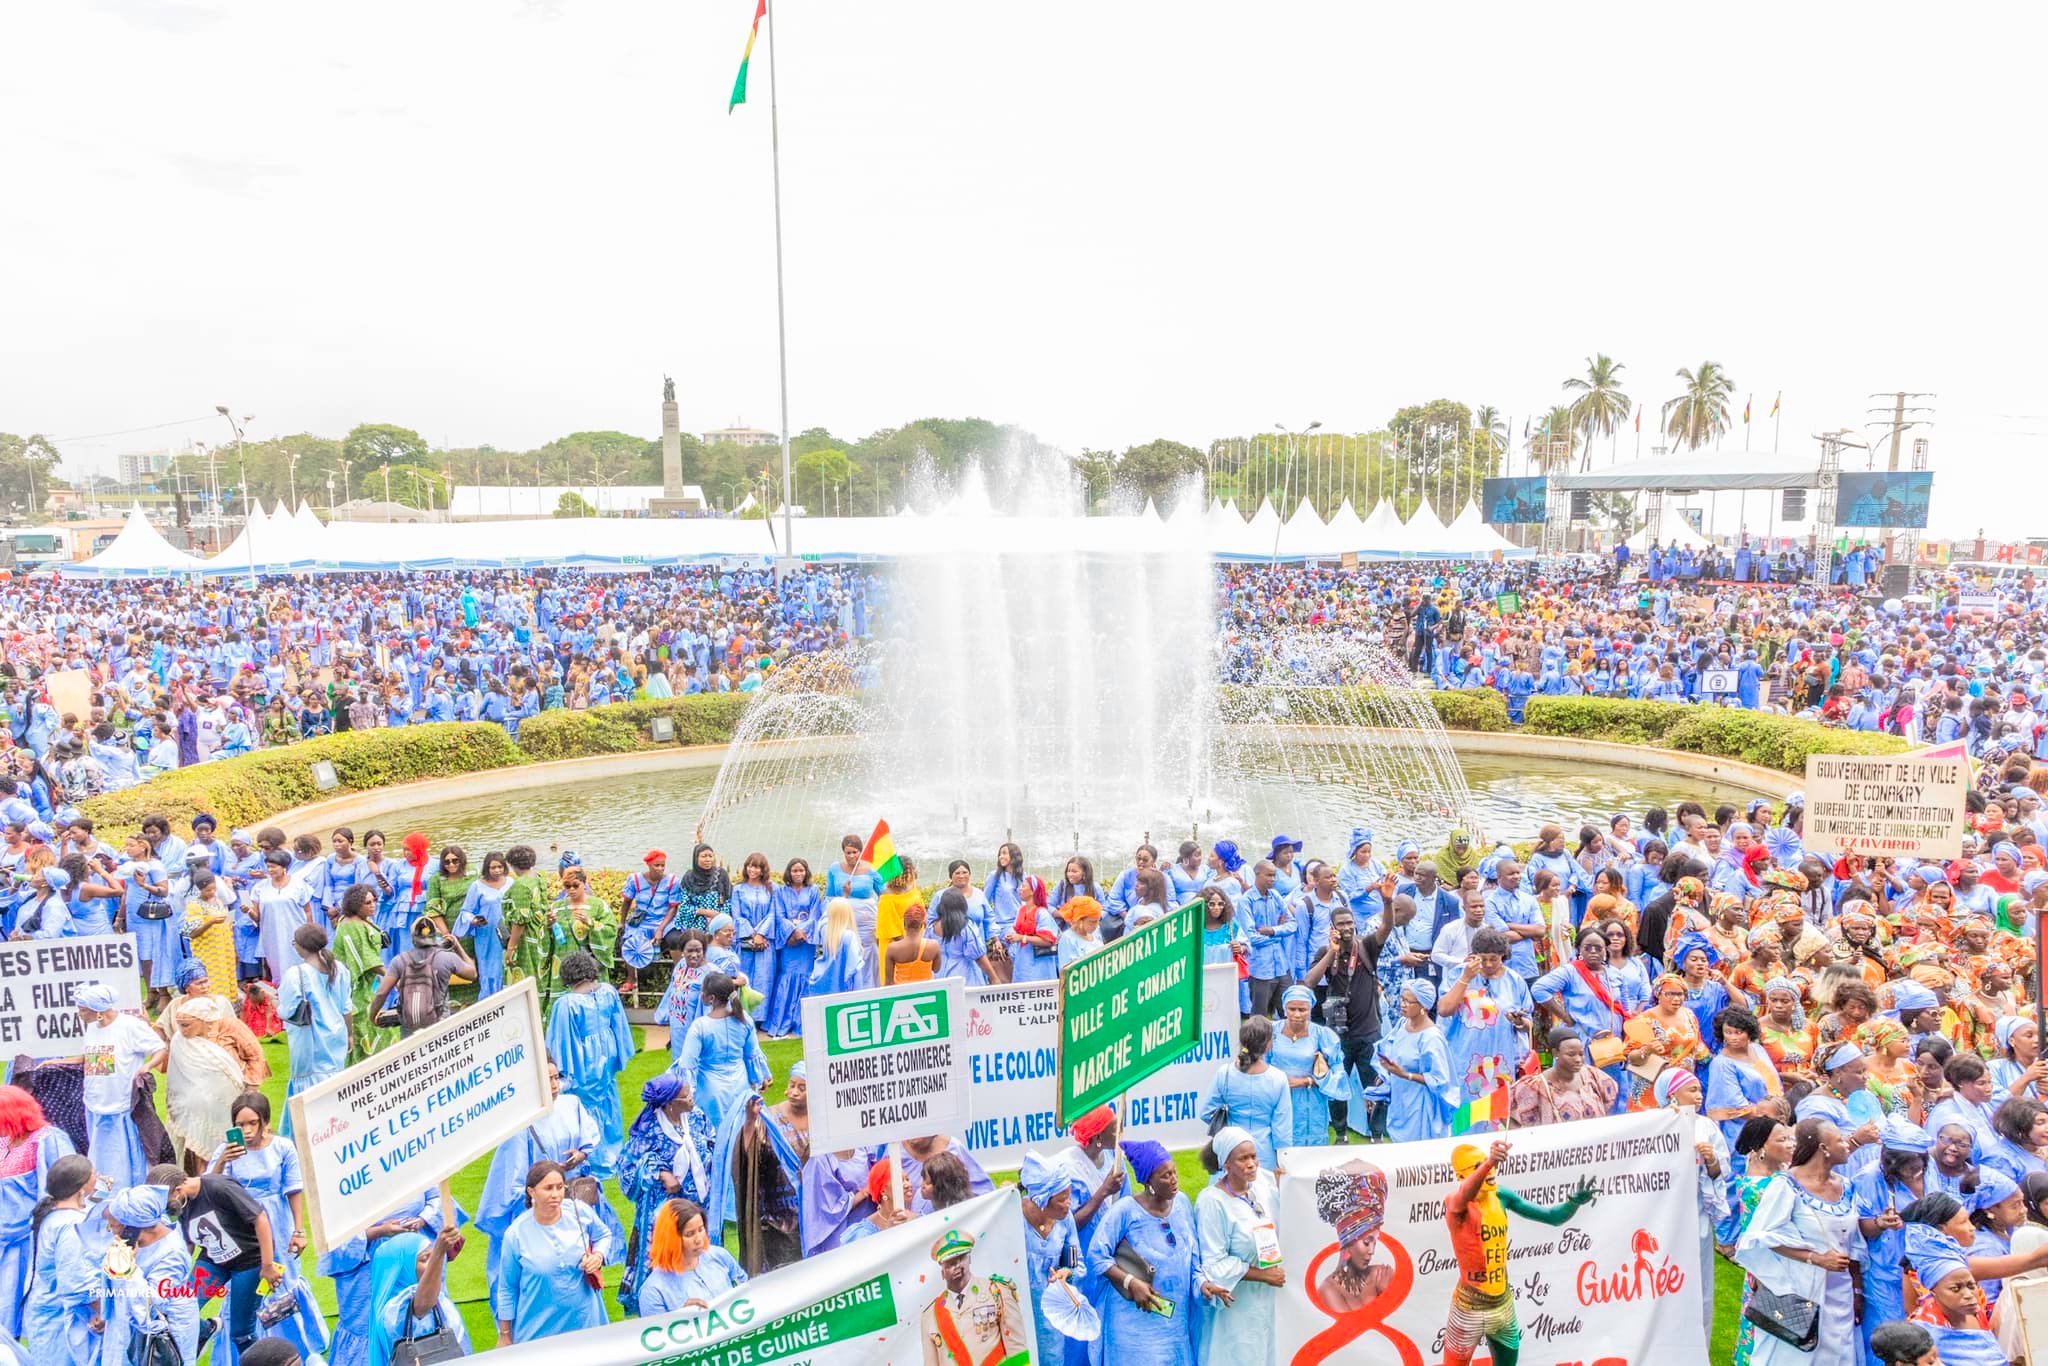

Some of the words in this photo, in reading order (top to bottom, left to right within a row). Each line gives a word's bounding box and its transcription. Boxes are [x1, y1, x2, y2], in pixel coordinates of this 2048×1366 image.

[1817, 761, 1892, 782] GOUVERNORAT
[1896, 764, 1908, 783] DE
[1913, 765, 1925, 783] LA
[1929, 765, 1957, 784] VILLE
[1845, 784, 1859, 800] DE
[1864, 785, 1925, 803] CONAKRY
[1814, 802, 1850, 818] BUREAU
[1852, 804, 1865, 818] DE
[1868, 804, 1954, 822] L'ADMINISTRATION
[1814, 819, 1826, 832] DU
[1829, 820, 1867, 835] MARCHE
[1869, 823, 1881, 836] DE
[1884, 823, 1951, 840] CHANGEMENT
[36, 943, 133, 974] FEMMES
[1069, 927, 1159, 997] GOUVERNORAT
[1164, 918, 1177, 947] DE
[1183, 910, 1193, 935] LA
[0, 987, 15, 1012] A
[32, 980, 99, 1009] FILIE
[980, 989, 1054, 1003] MINISTERE
[1071, 1002, 1104, 1042] VILLE
[1112, 988, 1128, 1020] DE
[1137, 956, 1187, 1004] CONAKRY
[0, 1016, 22, 1041] ET
[37, 1012, 88, 1039] CACA
[1141, 1006, 1183, 1056] NIGER
[338, 1058, 400, 1102] MINISTERE
[403, 1049, 417, 1066] DE
[419, 1006, 505, 1057] L'ENSEIGNEMENT
[351, 1092, 377, 1112] PRE-
[380, 1045, 461, 1095] UNIVERSITAIRE
[464, 1037, 474, 1050] ET
[479, 1029, 491, 1043] DE
[829, 1056, 878, 1085] CHAMBRE
[881, 1053, 894, 1076] DE
[897, 1044, 952, 1073] COMMERCE
[969, 1054, 981, 1084] E
[986, 1053, 1003, 1082] LE
[1006, 1048, 1058, 1081] COLON
[334, 1127, 381, 1165] VIVE
[389, 1105, 420, 1135] LES
[427, 1062, 493, 1113] FEMMES
[495, 1044, 525, 1073] POUR
[368, 1054, 474, 1120] L'ALPHABETISATION
[836, 1083, 885, 1108] D'INDUSTRIE
[887, 1081, 896, 1100] ET
[899, 1073, 947, 1099] D'ARTISANAT
[861, 1109, 876, 1128] DE
[880, 1100, 927, 1125] KALOUM
[965, 1119, 998, 1151] VIVE
[1003, 1116, 1021, 1145] LA
[1132, 1098, 1150, 1127] DE
[1154, 1091, 1198, 1124] L'ETAT
[339, 1164, 372, 1196] QUE
[379, 1127, 436, 1173] VIVENT
[441, 1113, 464, 1137] LES
[467, 1082, 516, 1122] HOMMES
[1395, 1163, 1454, 1188] MINISTERE
[1530, 1145, 1593, 1173] ETRANGERES
[1595, 1144, 1607, 1162] DE
[1610, 1133, 1680, 1160] L'INTEGRATION
[1608, 1171, 1671, 1196] L'ETRANGER
[1558, 1228, 1593, 1254] Fête
[1468, 1271, 1488, 1283] LES
[1577, 1228, 1685, 1306] Guinée
[772, 1281, 882, 1330] D'INDUSTRIE
[1525, 1271, 1551, 1306] Les
[640, 1299, 756, 1351] CCIAG
[1527, 1313, 1583, 1342] Monde
[728, 1345, 753, 1366] DE
[758, 1321, 829, 1358] GUINÉE
